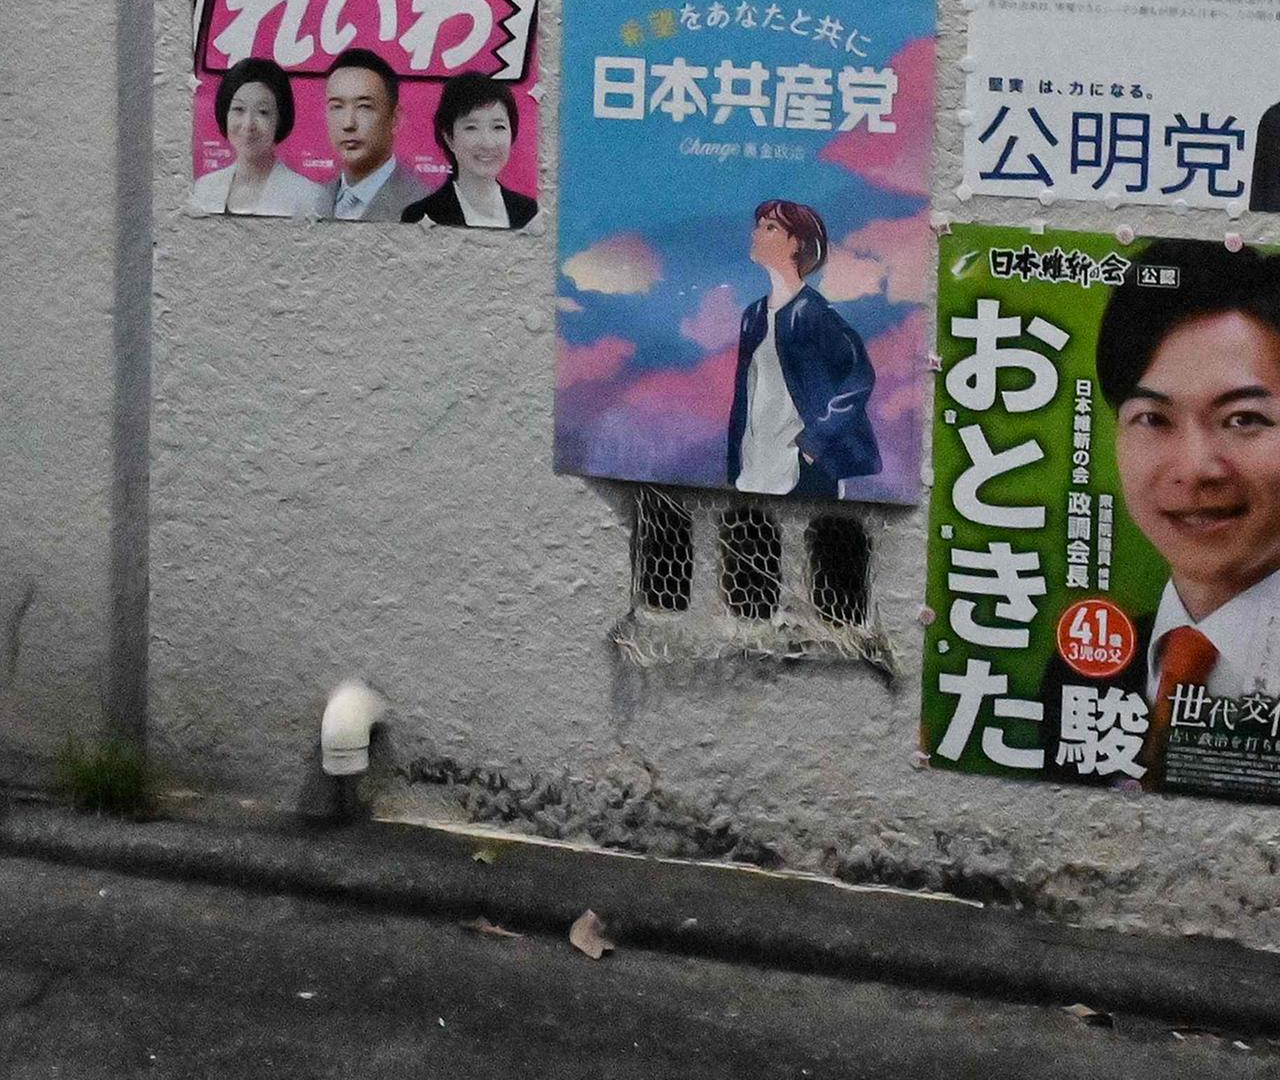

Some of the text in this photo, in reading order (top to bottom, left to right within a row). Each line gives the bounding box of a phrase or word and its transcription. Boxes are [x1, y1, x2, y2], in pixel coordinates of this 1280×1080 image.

[593, 55, 899, 134] 日本共産党
[679, 137, 741, 162] Change
[978, 105, 1246, 199] 公明党
[990, 245, 1131, 288] 日本維新の会
[1072, 379, 1092, 484] 日本維新の会
[936, 299, 1070, 770] おときた
[1056, 684, 1150, 780] 駿
